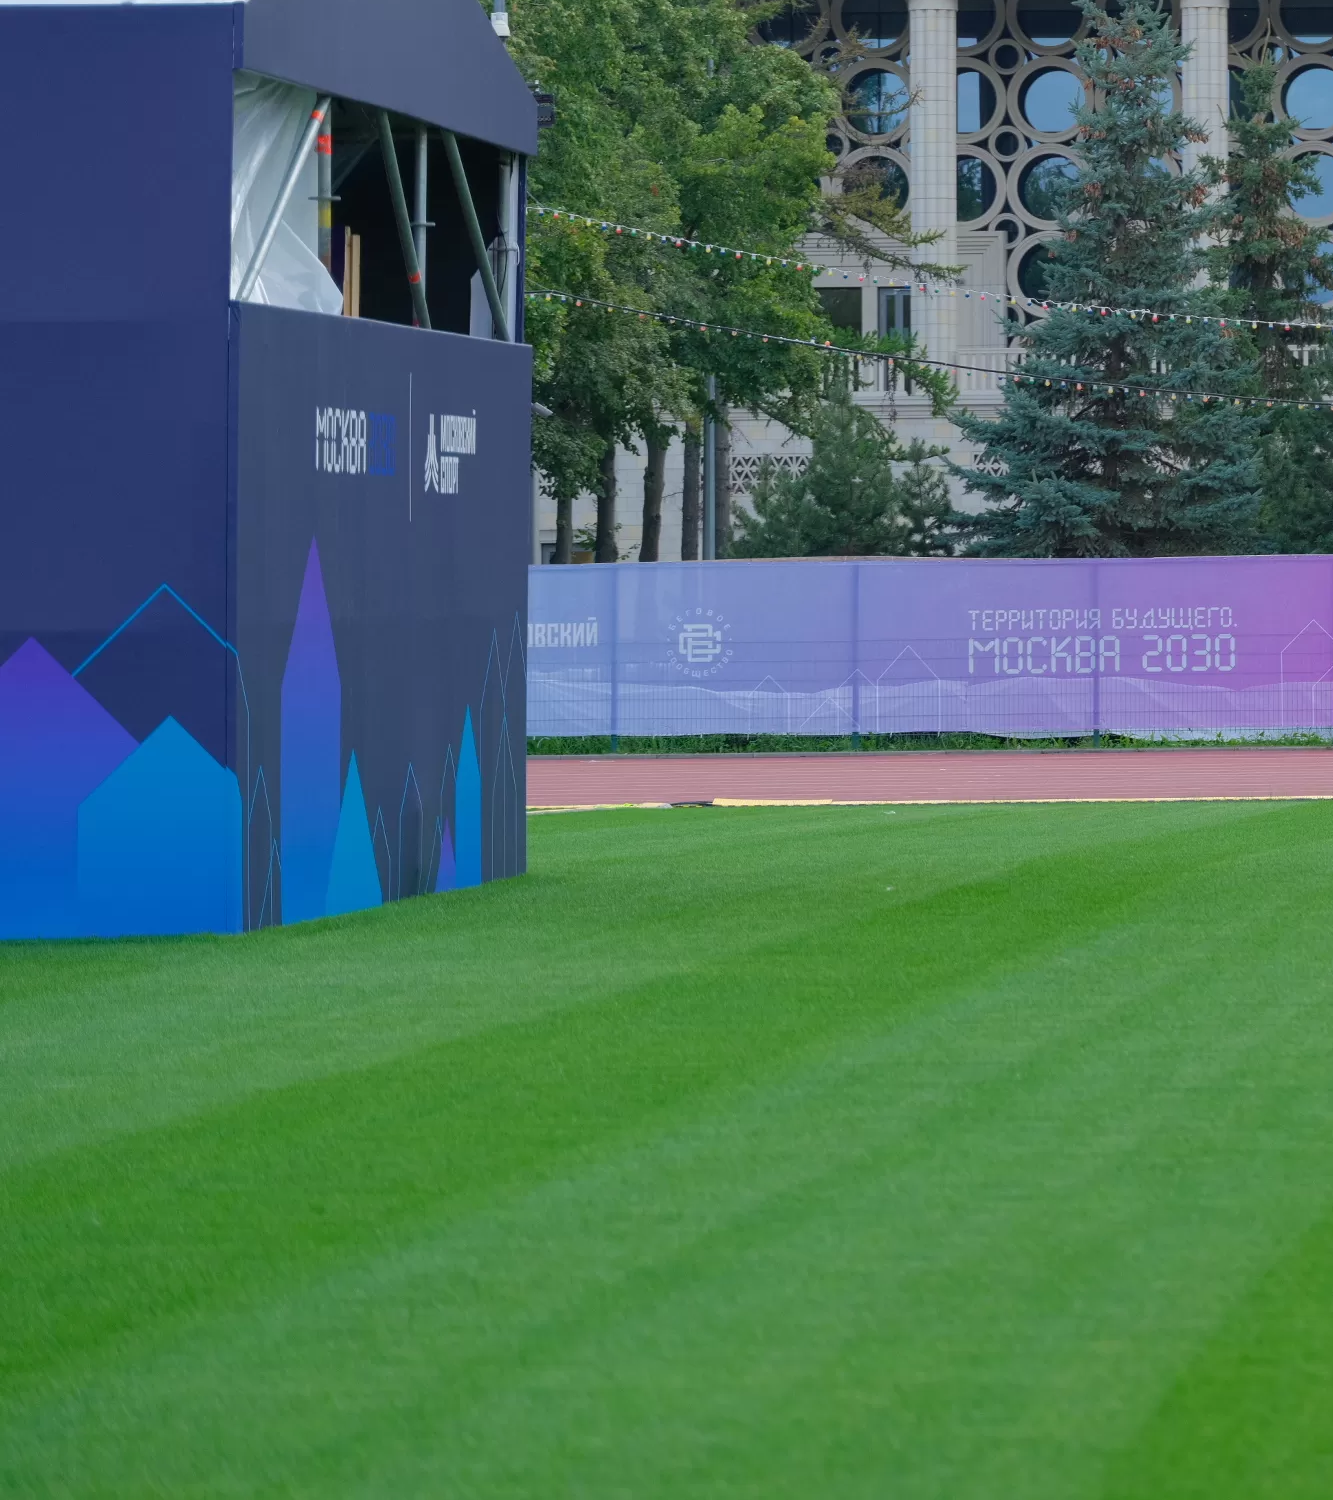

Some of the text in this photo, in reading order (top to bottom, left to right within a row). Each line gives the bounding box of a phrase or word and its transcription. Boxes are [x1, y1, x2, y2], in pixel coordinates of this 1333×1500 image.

[316, 406, 367, 475] МОСКВА
[440, 456, 459, 494] СПОРТ
[968, 606, 1238, 631] ТЕРРИТОРИЯ БУДУЩЕГО.
[968, 633, 1236, 674] МОСКВА 2030
